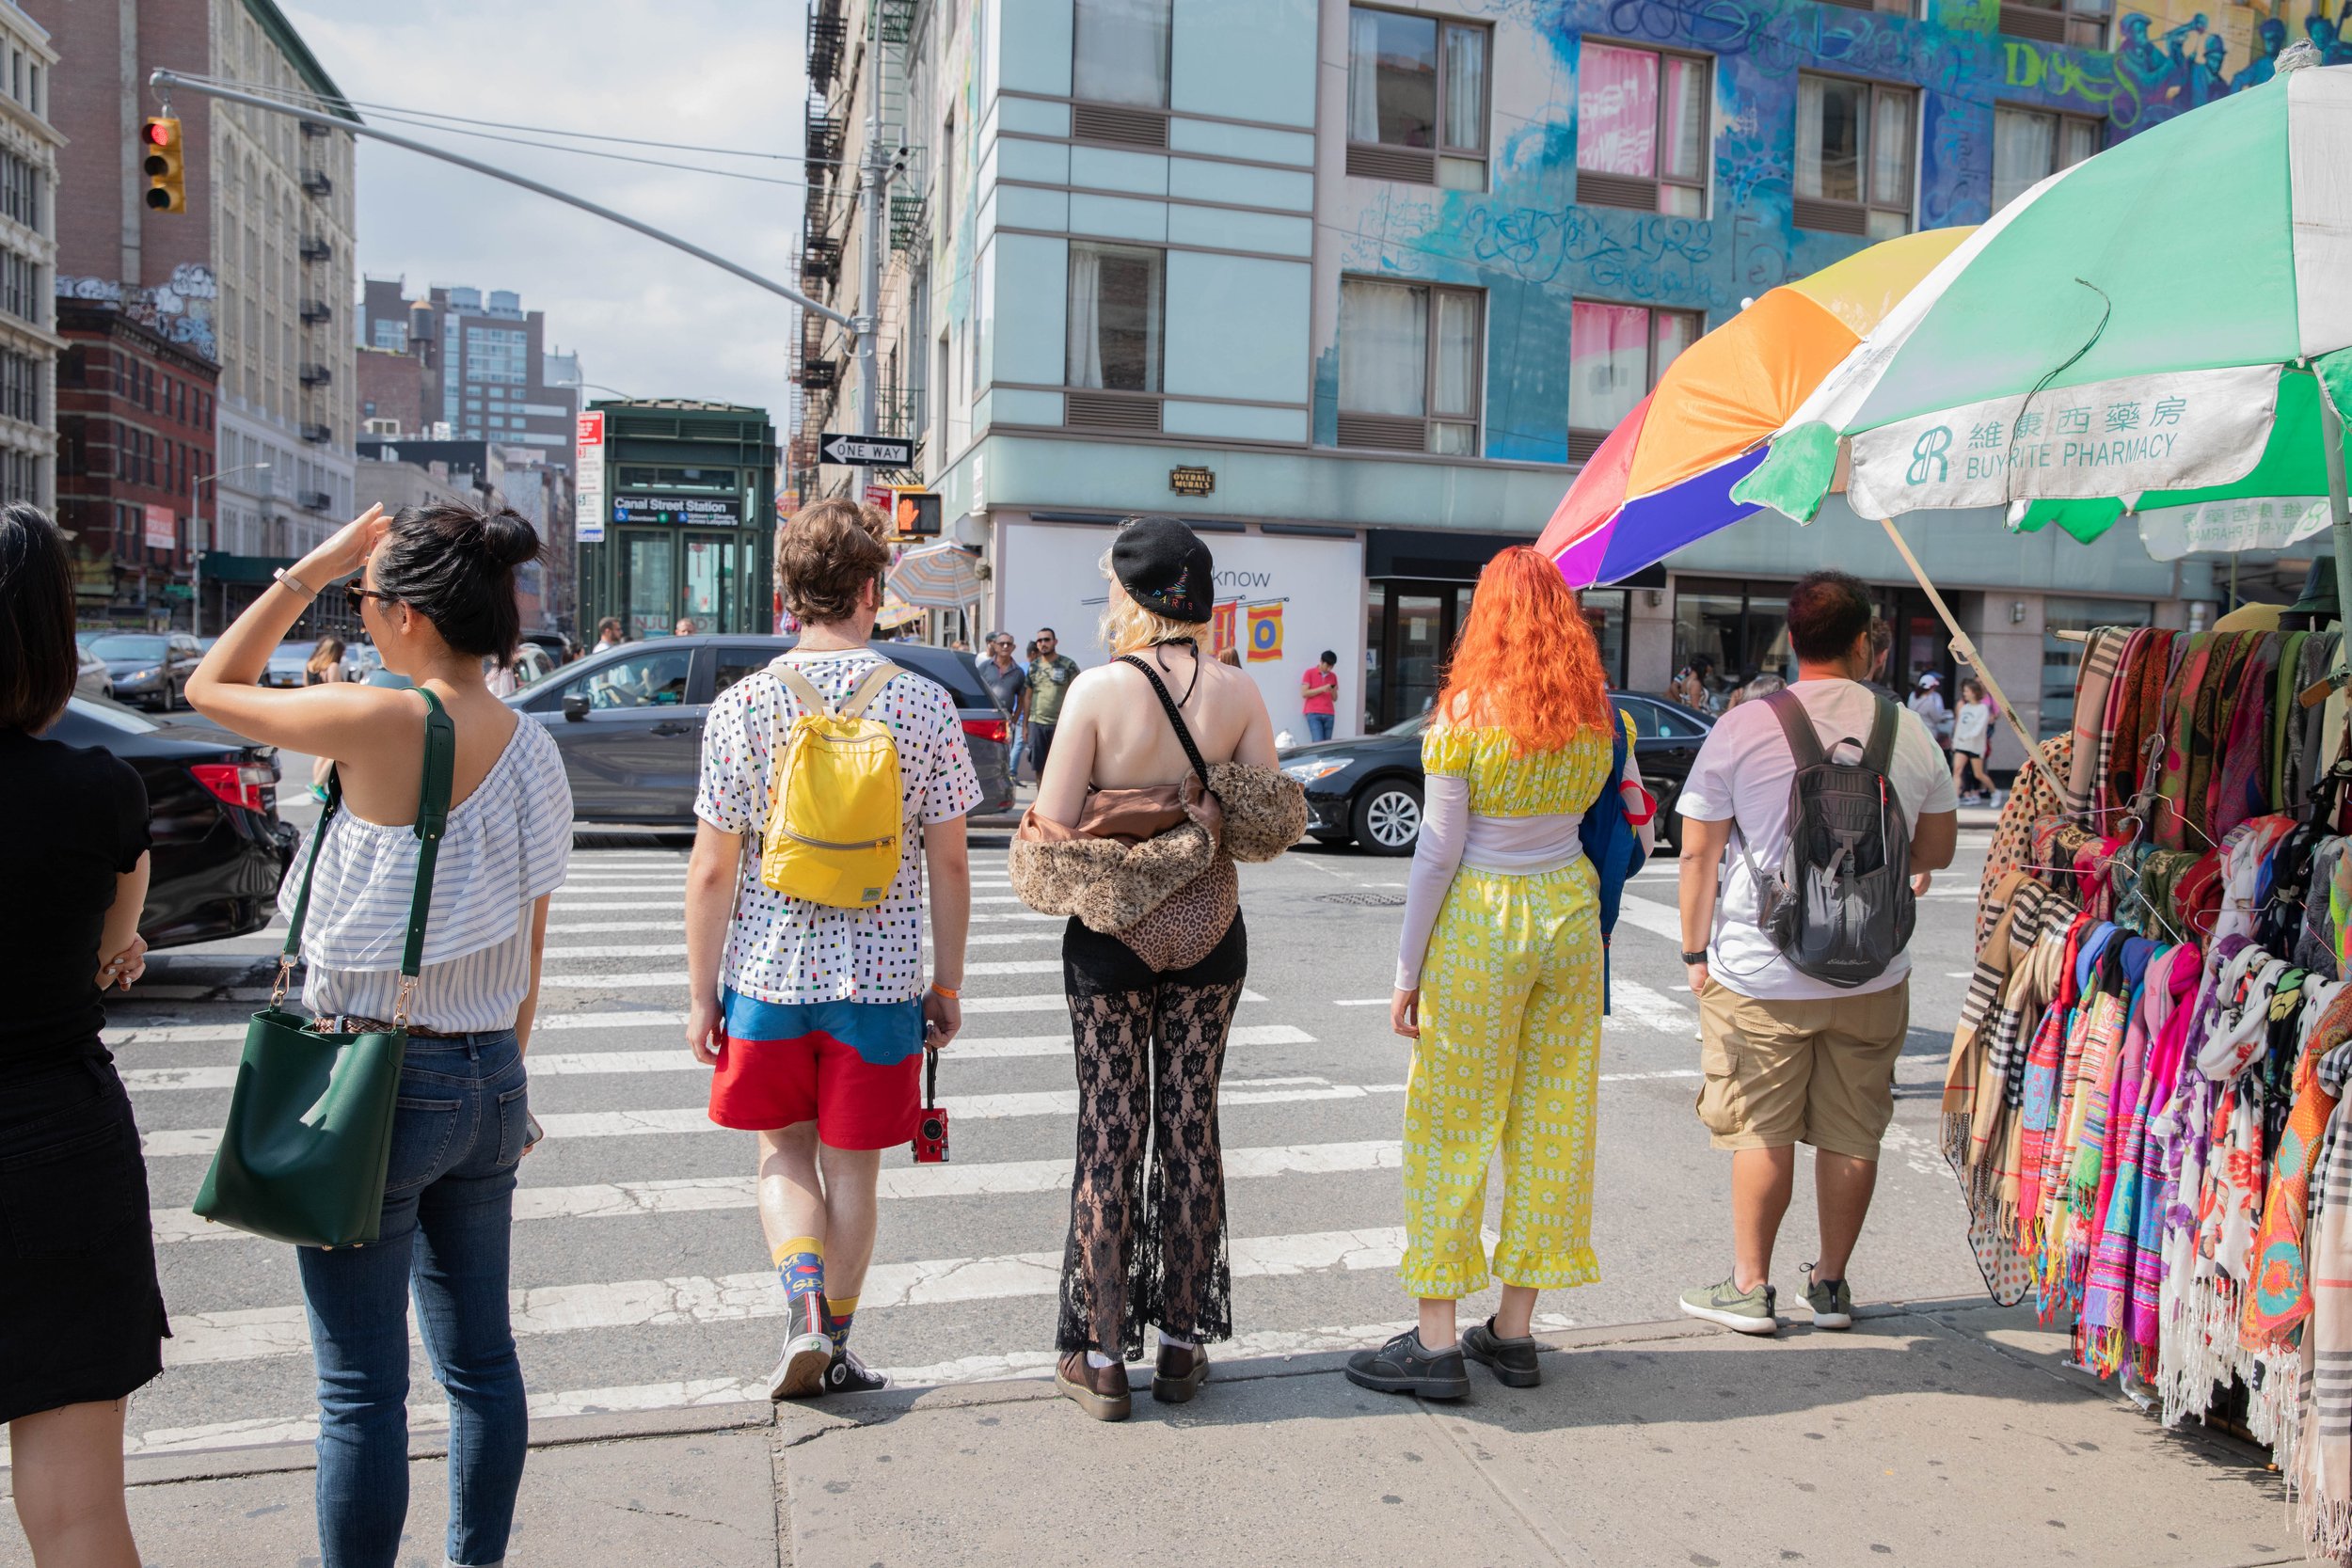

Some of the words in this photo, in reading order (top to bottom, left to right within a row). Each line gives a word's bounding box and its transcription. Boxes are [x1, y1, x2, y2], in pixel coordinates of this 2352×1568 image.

[836, 445, 866, 458] ONE
[872, 447, 901, 460] WAY
[2063, 433, 2180, 467] PHARMACY
[1173, 473, 1212, 483] OVERALL
[1175, 481, 1210, 489] MURALS
[614, 498, 648, 510] Canal
[649, 499, 684, 512] Street
[686, 500, 726, 514] Station
[628, 514, 658, 523] Downtown
[1152, 589, 1194, 611] PARIS
